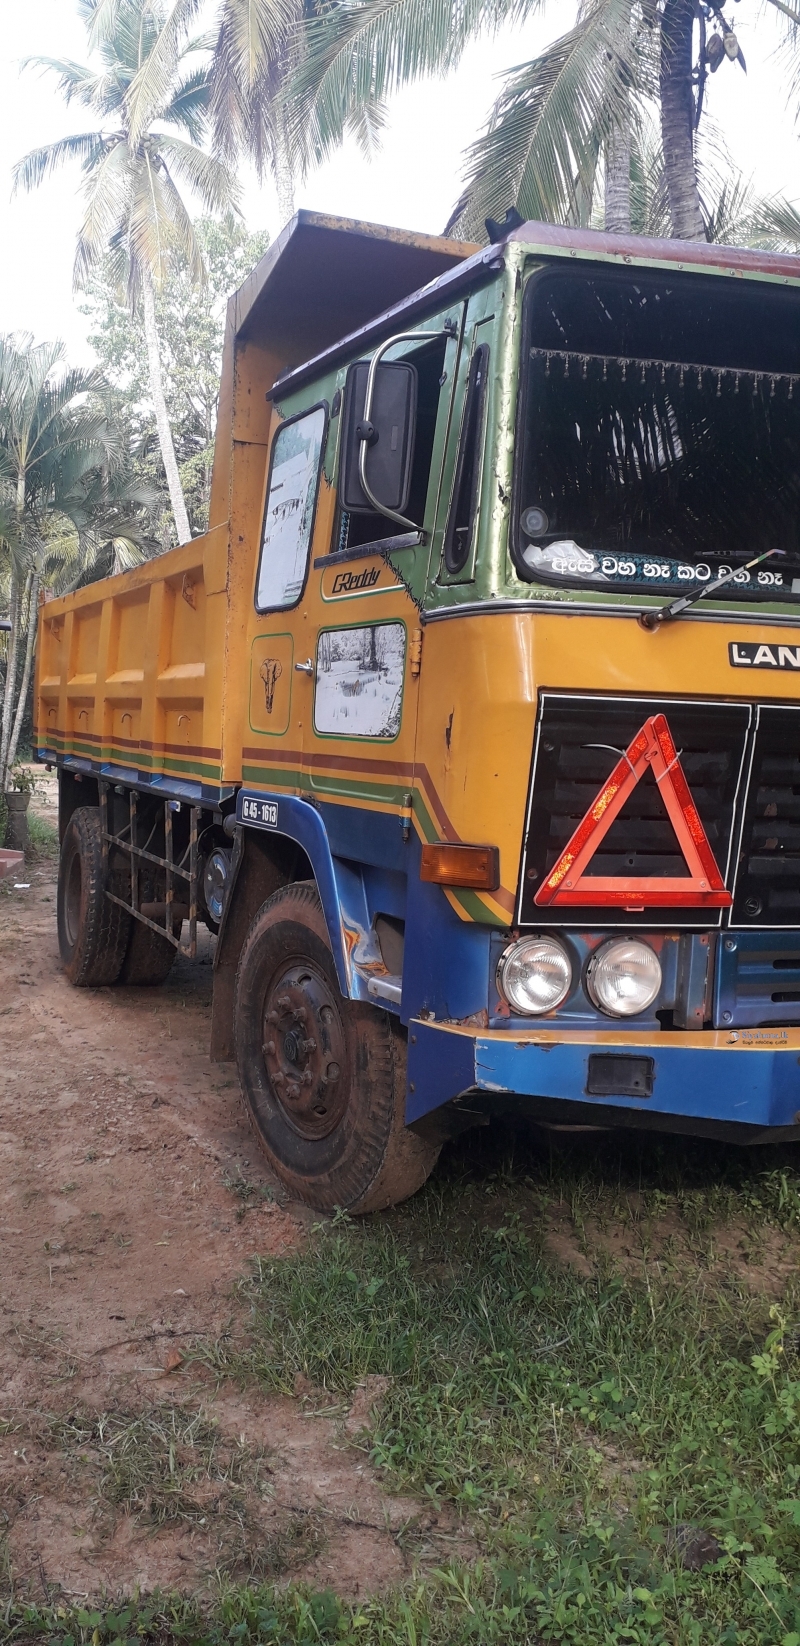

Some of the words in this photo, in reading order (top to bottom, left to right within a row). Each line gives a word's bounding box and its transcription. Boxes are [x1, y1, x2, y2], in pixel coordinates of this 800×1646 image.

[332, 567, 381, 594] GReddy
[601, 557, 636, 576] වහ
[643, 563, 670, 578] නෑ
[677, 563, 711, 581] කට
[757, 571, 783, 586] නෑ
[732, 644, 800, 667] LAN
